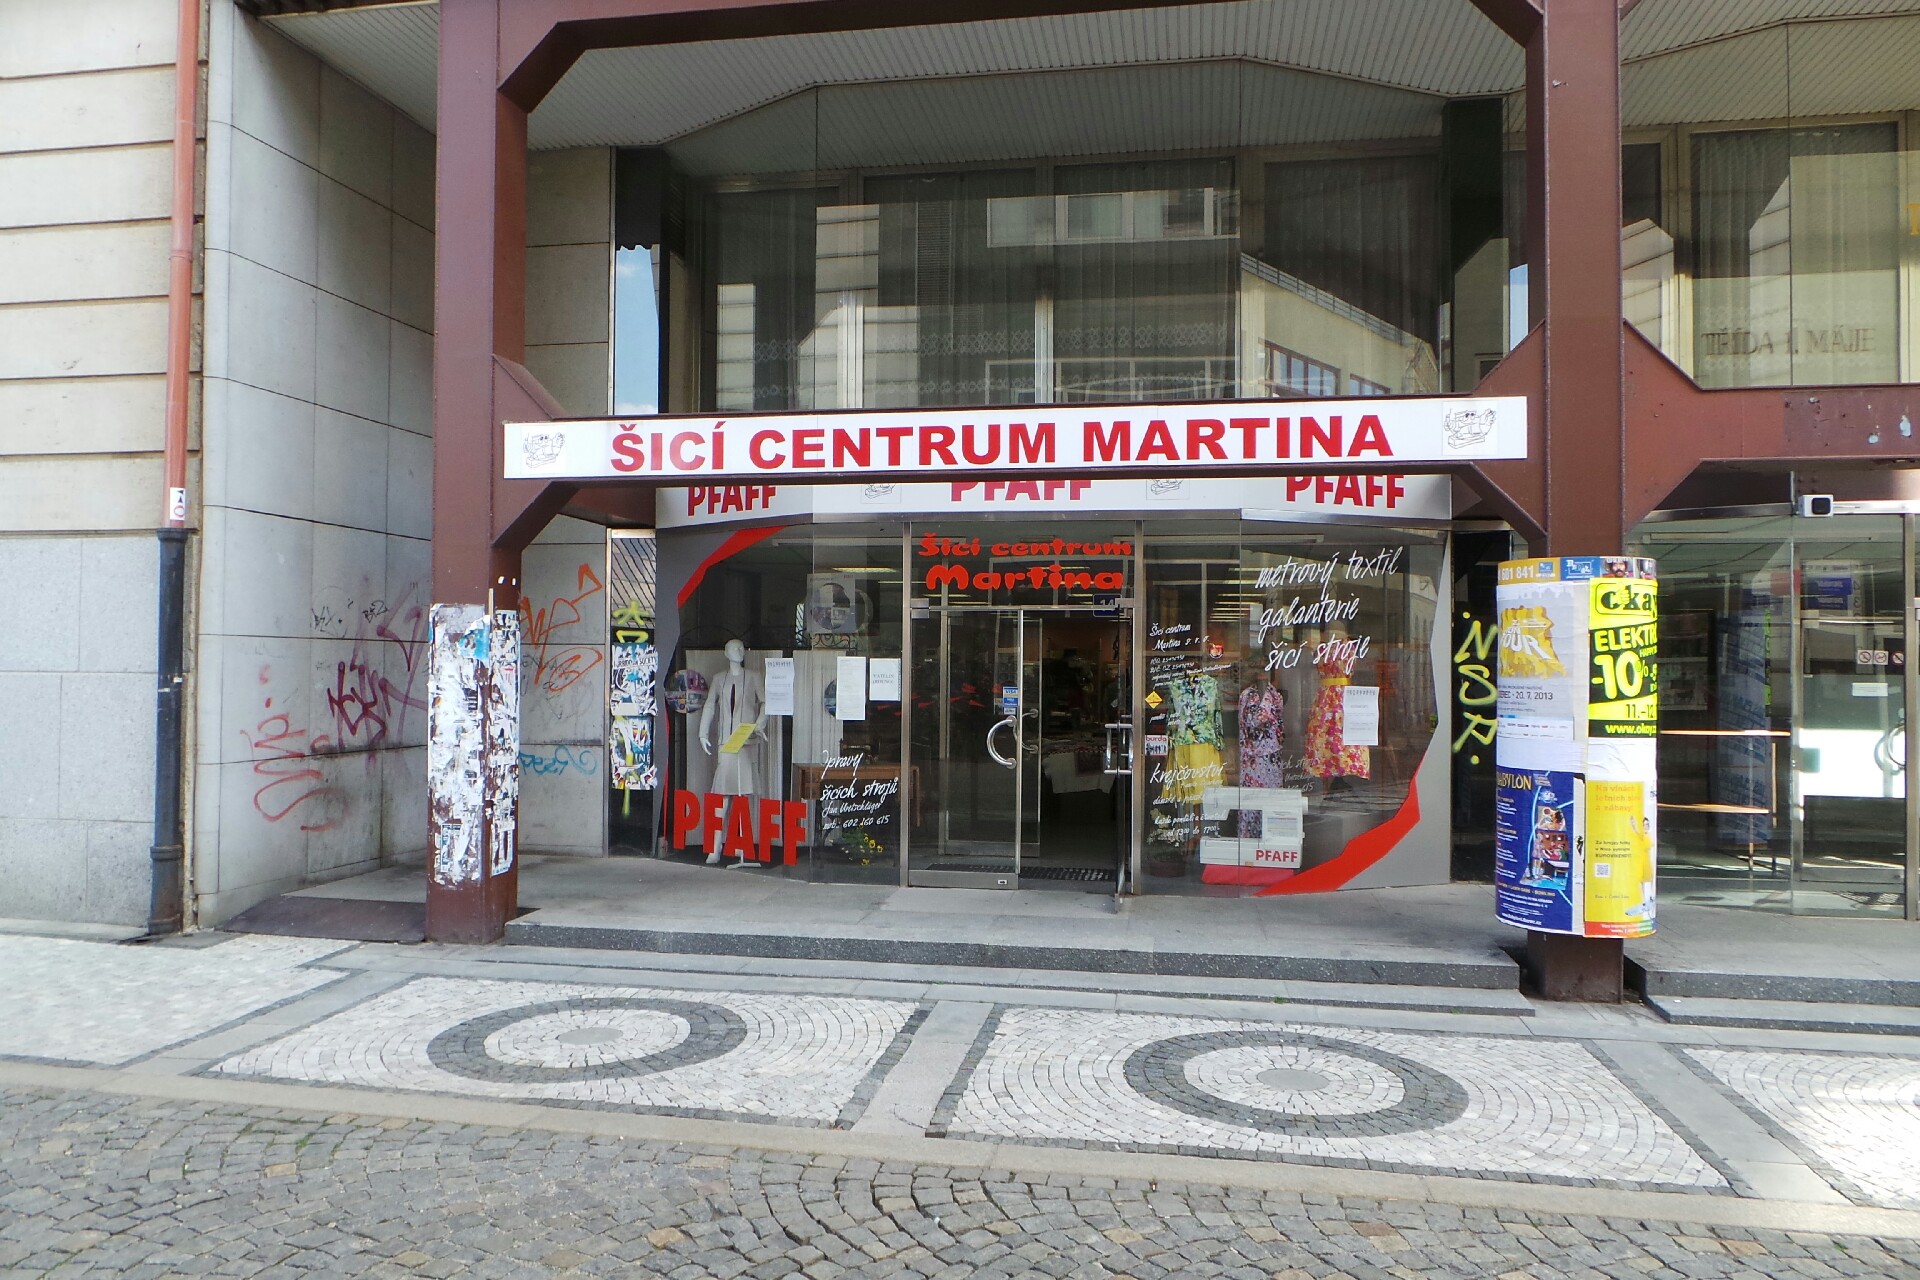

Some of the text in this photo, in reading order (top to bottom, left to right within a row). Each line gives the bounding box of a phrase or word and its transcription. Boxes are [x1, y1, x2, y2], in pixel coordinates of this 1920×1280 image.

[610, 414, 1394, 472] ŠICÍ CENTRUM MARTINA
[687, 484, 776, 517] PFAFF
[1285, 474, 1405, 509] PFAFF
[918, 532, 1132, 556] Šicí centrum
[925, 564, 1125, 590] Martina
[1254, 545, 1404, 600] metrový textil
[1257, 592, 1361, 644] galanterie
[1264, 633, 1371, 676] šicí stroje
[1534, 691, 1554, 701] 2013
[1145, 734, 1168, 742] burda
[820, 776, 899, 804] šicích strojů
[673, 789, 808, 866] PFAFF
[842, 818, 859, 829] 602
[876, 814, 891, 825] 615
[1255, 849, 1298, 863] PFAFF
